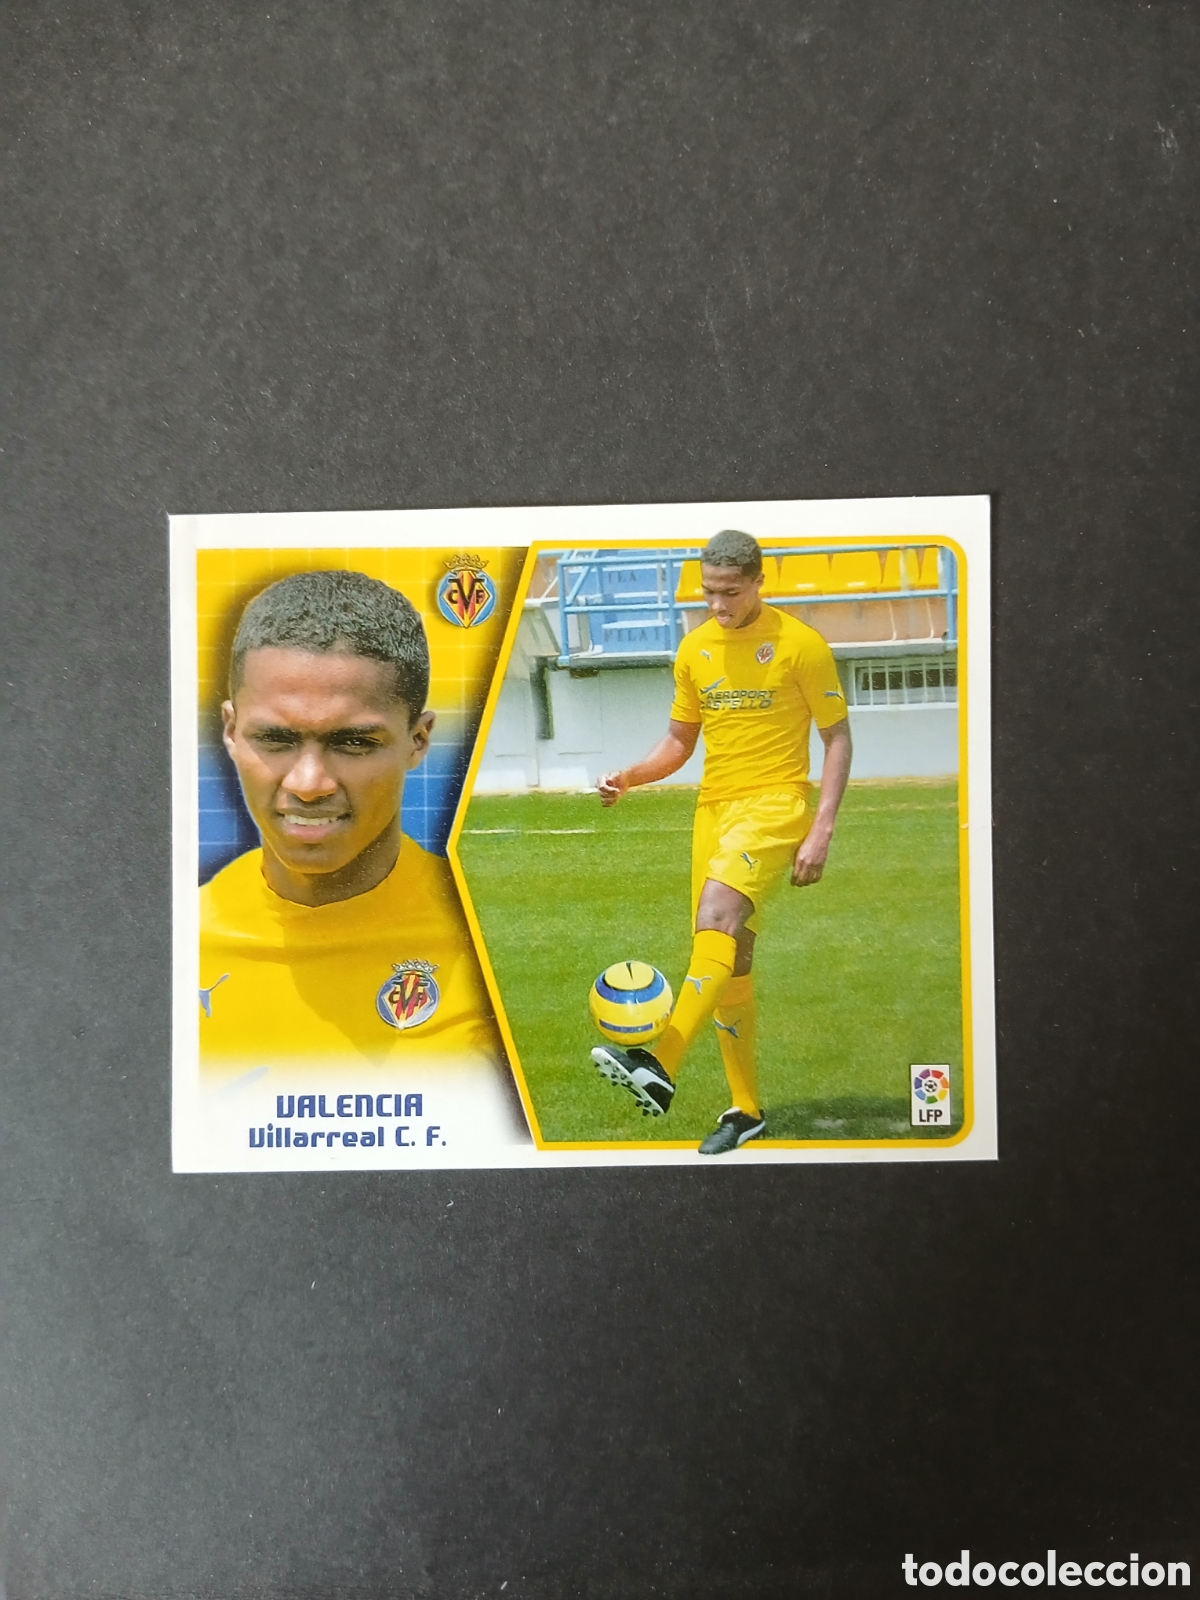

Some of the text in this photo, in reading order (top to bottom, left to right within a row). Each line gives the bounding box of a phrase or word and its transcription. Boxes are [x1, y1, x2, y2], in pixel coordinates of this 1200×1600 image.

[706, 689, 777, 700] AEROPORT
[276, 1093, 423, 1118] VALENCIA
[918, 1108, 943, 1123] LFP
[249, 1123, 447, 1148] Villarreal C. F.
